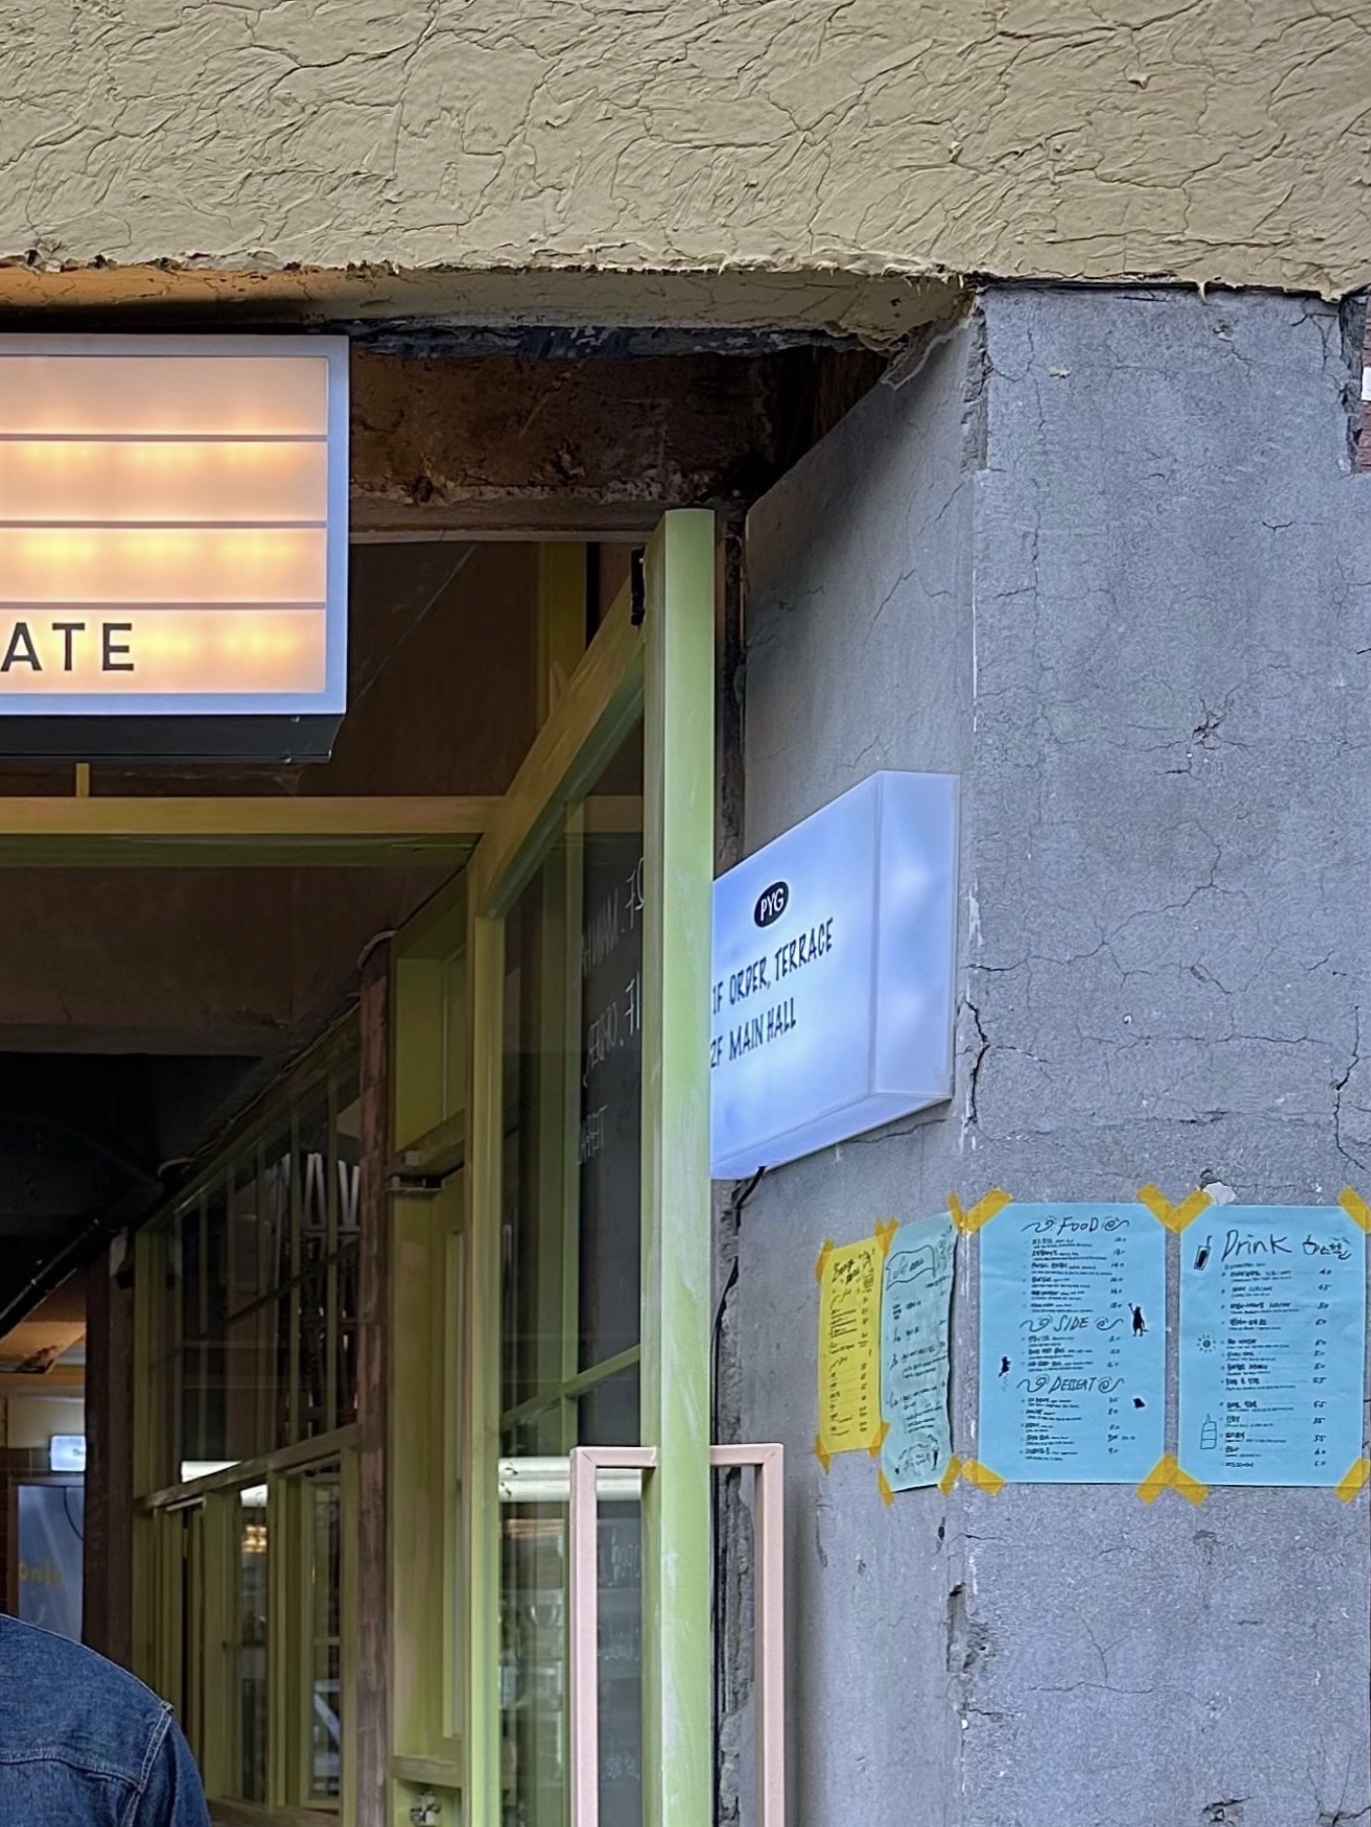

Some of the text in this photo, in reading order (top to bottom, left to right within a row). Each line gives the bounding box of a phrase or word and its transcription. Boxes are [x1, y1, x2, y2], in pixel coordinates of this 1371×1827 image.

[759, 887, 785, 922] PYG
[712, 917, 834, 1015] 1F ORDER, TERRACE
[711, 997, 796, 1068] 2F MAIN HALL
[1220, 1229, 1293, 1263] Drink
